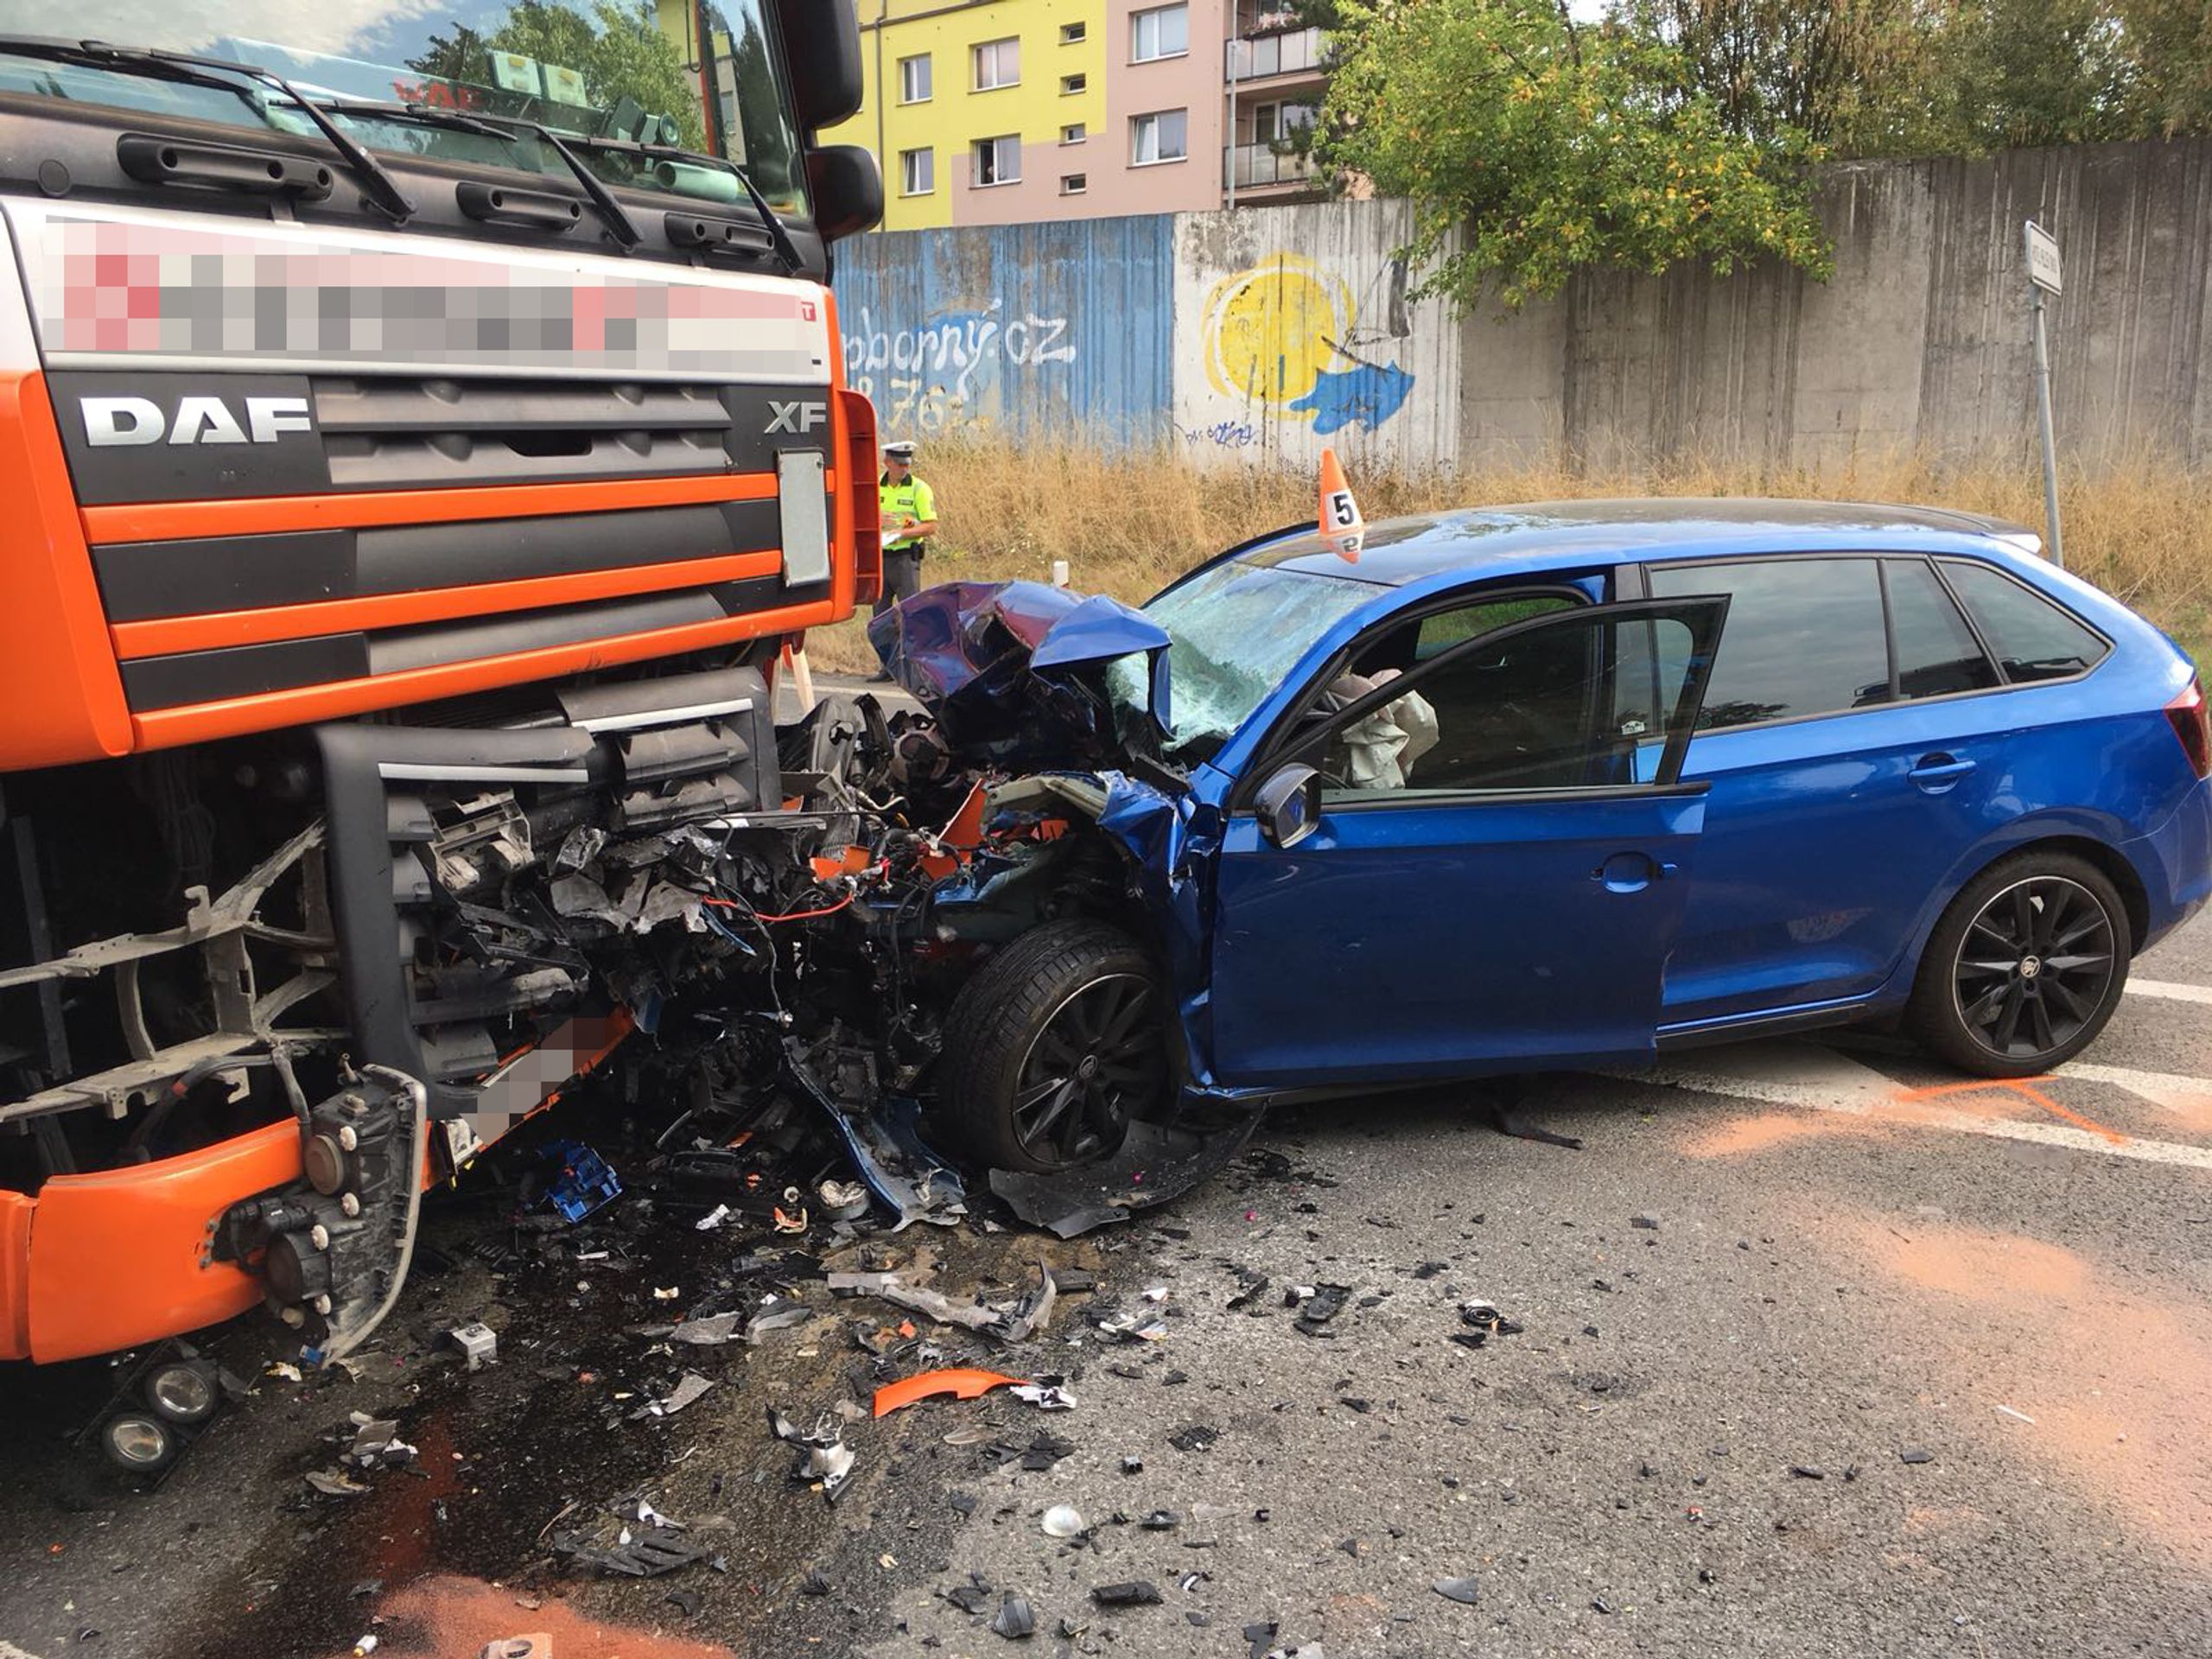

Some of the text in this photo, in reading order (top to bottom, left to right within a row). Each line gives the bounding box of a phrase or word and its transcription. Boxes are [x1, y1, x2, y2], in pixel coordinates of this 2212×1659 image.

[80, 397, 311, 446] DAF
[764, 401, 826, 434] XF
[1333, 493, 1355, 525] 5
